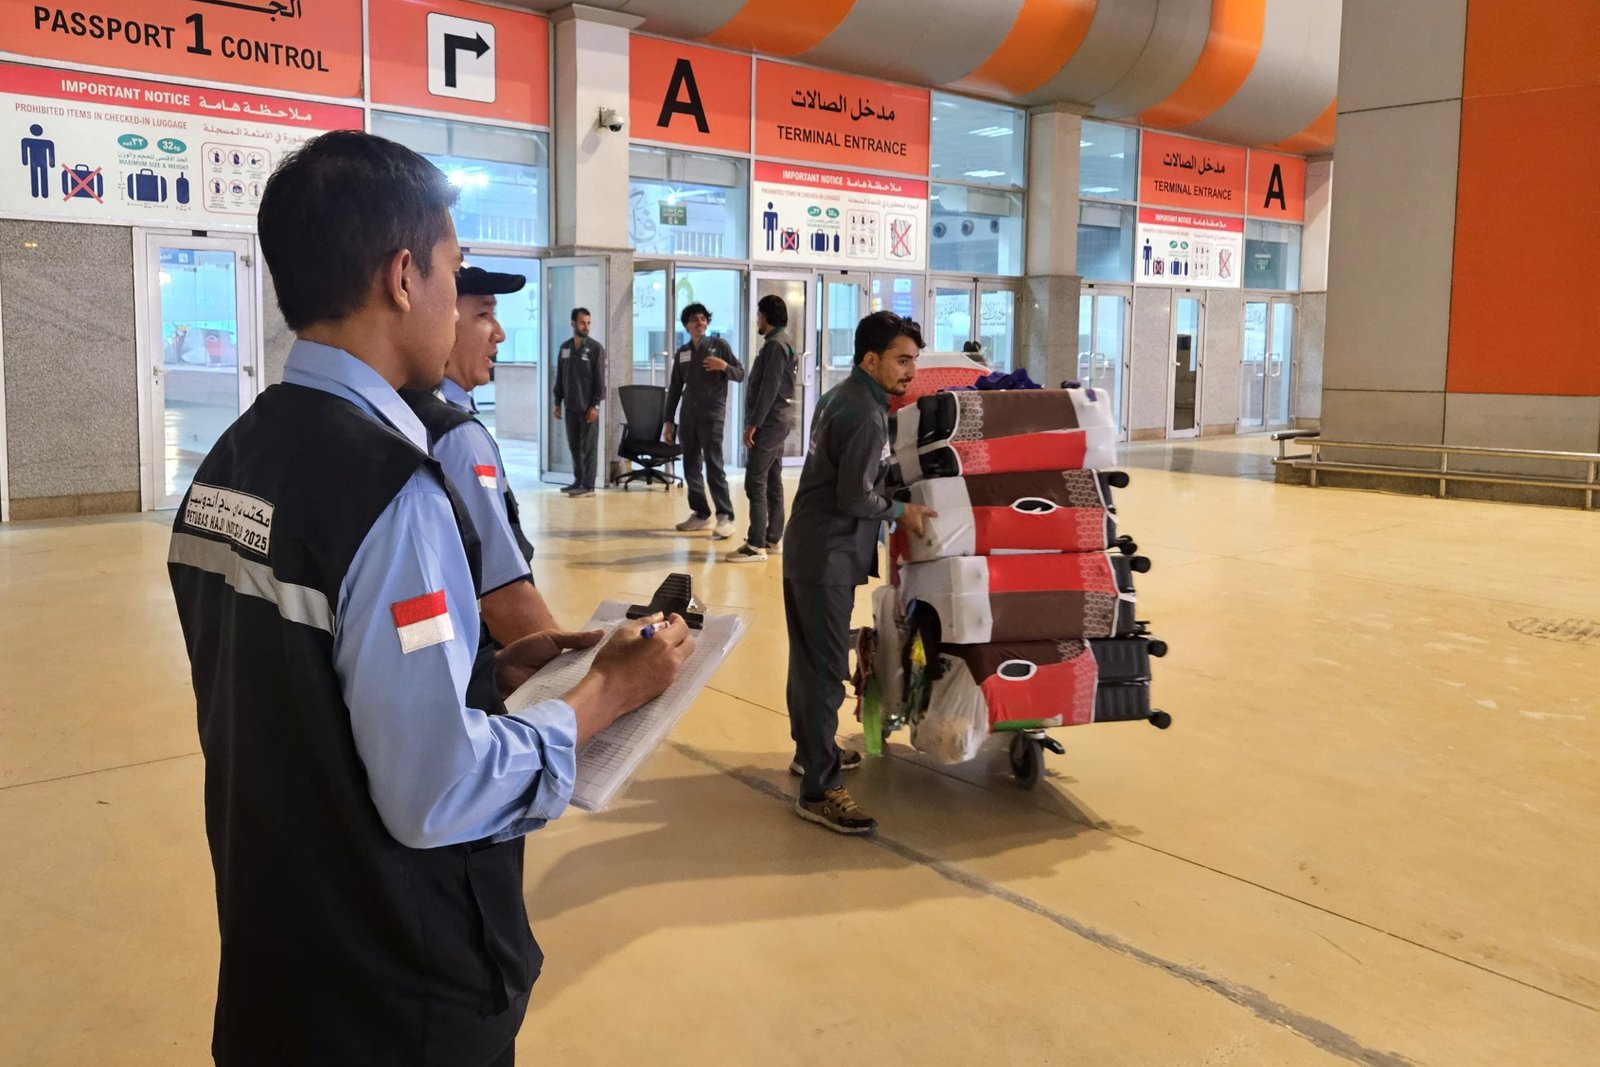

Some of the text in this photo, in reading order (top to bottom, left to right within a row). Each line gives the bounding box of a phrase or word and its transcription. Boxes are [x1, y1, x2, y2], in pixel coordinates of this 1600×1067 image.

[34, 5, 329, 73] PASSPORT 1 CONTROL
[61, 79, 190, 106] IMPORTANT NOTICE
[656, 57, 710, 134] A
[791, 88, 896, 122] مدخل الصالات
[15, 102, 187, 130] PROHIBITED ITEMS IN CHECKED-IN LUGGAGE
[199, 96, 313, 121] ملاحظة هامة
[777, 125, 908, 156] TERMINAL ENTRANCE
[119, 159, 148, 167] MAXIMUM
[782, 169, 843, 185] IMPORTANT NOTICE
[1163, 151, 1226, 175] مدخل الصالات
[1154, 180, 1232, 200] TERMINAL ENTRANCE
[1263, 163, 1286, 211] A
[187, 509, 208, 527] PETUGAS
[243, 529, 267, 551] 2025
